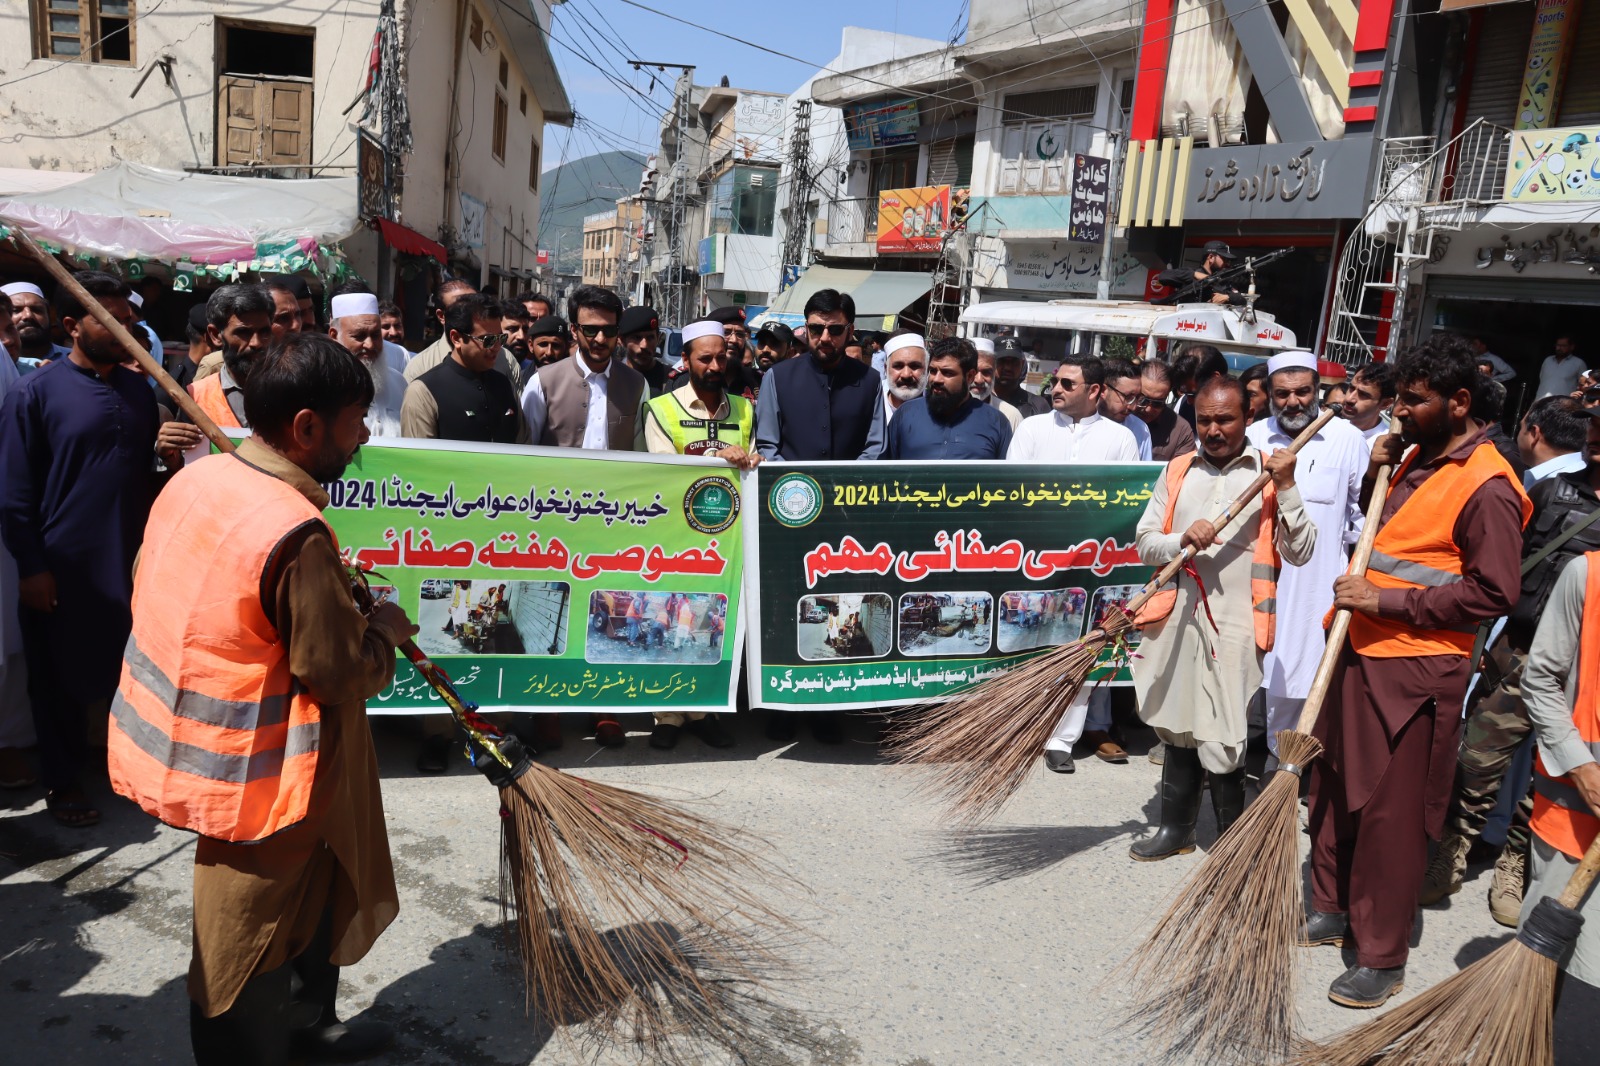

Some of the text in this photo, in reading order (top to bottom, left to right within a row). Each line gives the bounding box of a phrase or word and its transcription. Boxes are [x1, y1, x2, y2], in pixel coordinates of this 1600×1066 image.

[1537, 11, 1565, 25] Sports
[1076, 163, 1108, 186] گوادر
[1197, 158, 1239, 203] شوز
[689, 440, 731, 450] CIVIL DEFENC
[324, 475, 669, 526] خیبر پختونخواہ عوامی ایجنڈا 024
[833, 484, 880, 506] 2024
[882, 480, 947, 508] ایجنڈا
[946, 482, 1007, 508] عوامی
[1009, 482, 1108, 509] پختونخواہ
[1109, 482, 1153, 507] خیبر
[477, 531, 569, 572] ہفتہ
[571, 538, 728, 583] خصوصی
[803, 535, 896, 589] مہم
[895, 528, 1024, 582] صفائی
[545, 681, 567, 697] دیر
[567, 669, 644, 699] ایڈمنسٹریشن
[644, 671, 697, 699] ڈسٹرکٹ
[824, 664, 911, 693] ایڈمنسٹریشن
[911, 664, 968, 690] میونسپل
